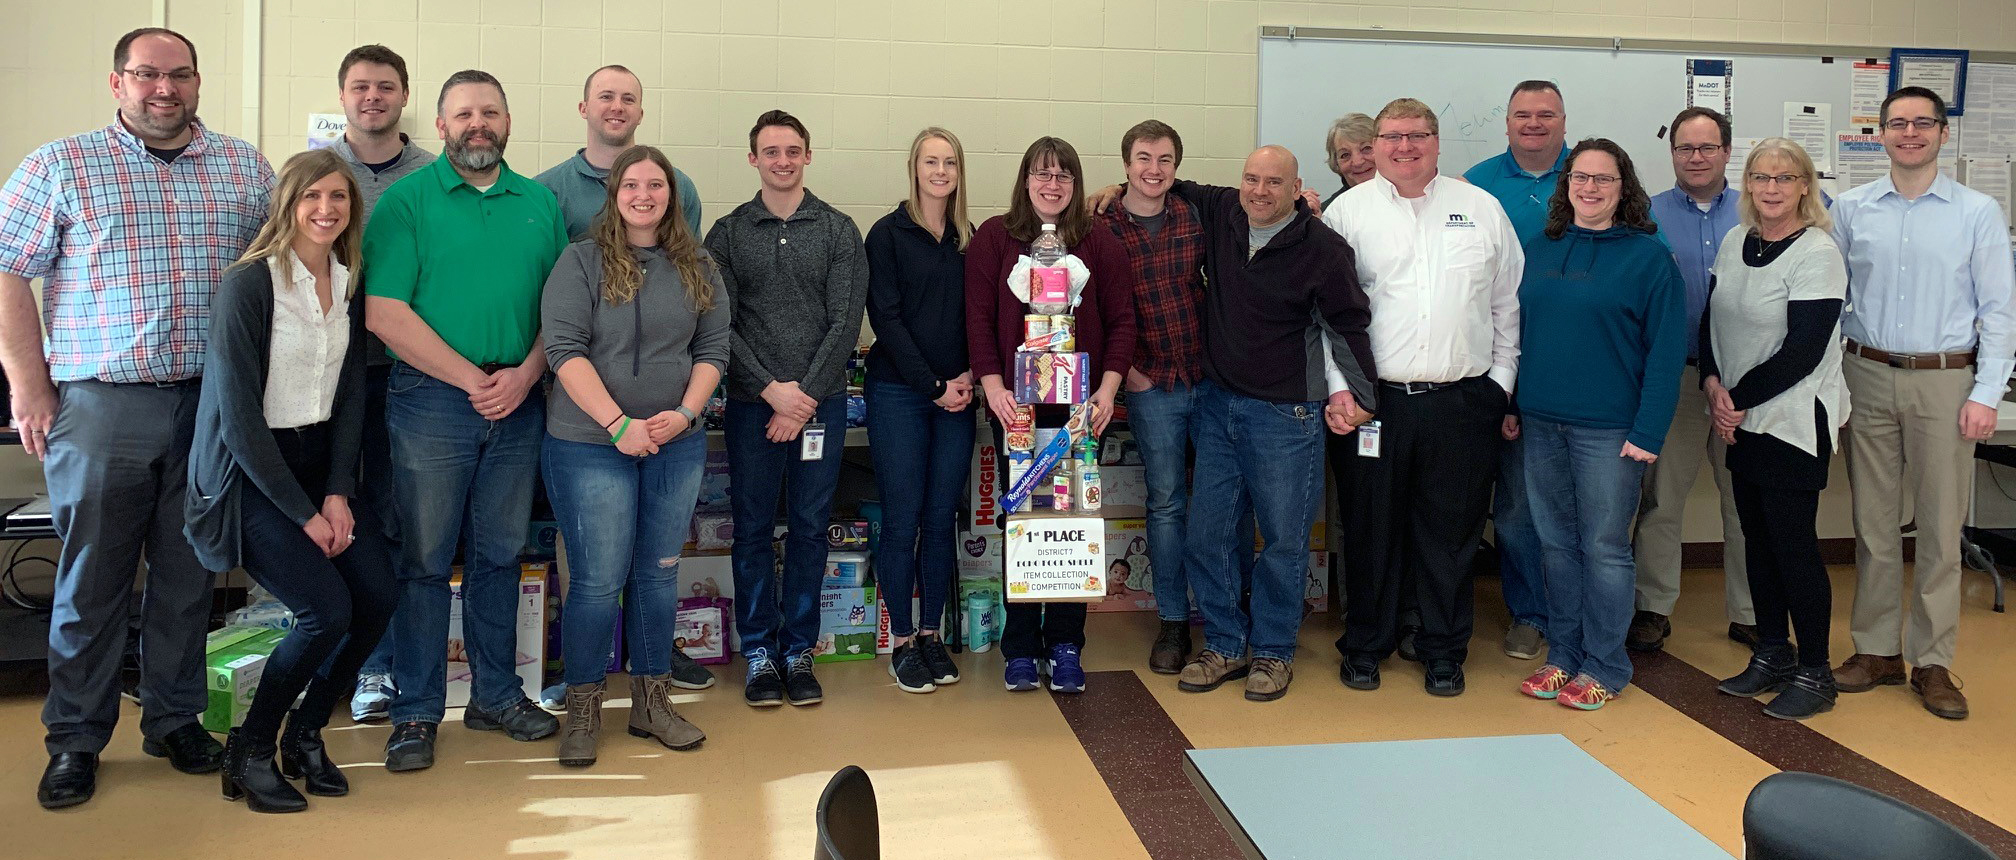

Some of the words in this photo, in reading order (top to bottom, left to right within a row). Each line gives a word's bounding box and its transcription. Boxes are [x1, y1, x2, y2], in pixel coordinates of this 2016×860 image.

[317, 118, 346, 130] Dove
[1026, 338, 1049, 347] Colgate
[1008, 476, 1030, 502] Reynolds
[1028, 453, 1050, 478] KITCHENS
[976, 446, 996, 526] HUGGIES
[833, 529, 840, 538] U
[1044, 530, 1086, 542] PLACE
[820, 593, 842, 601] night
[866, 596, 873, 604] 5
